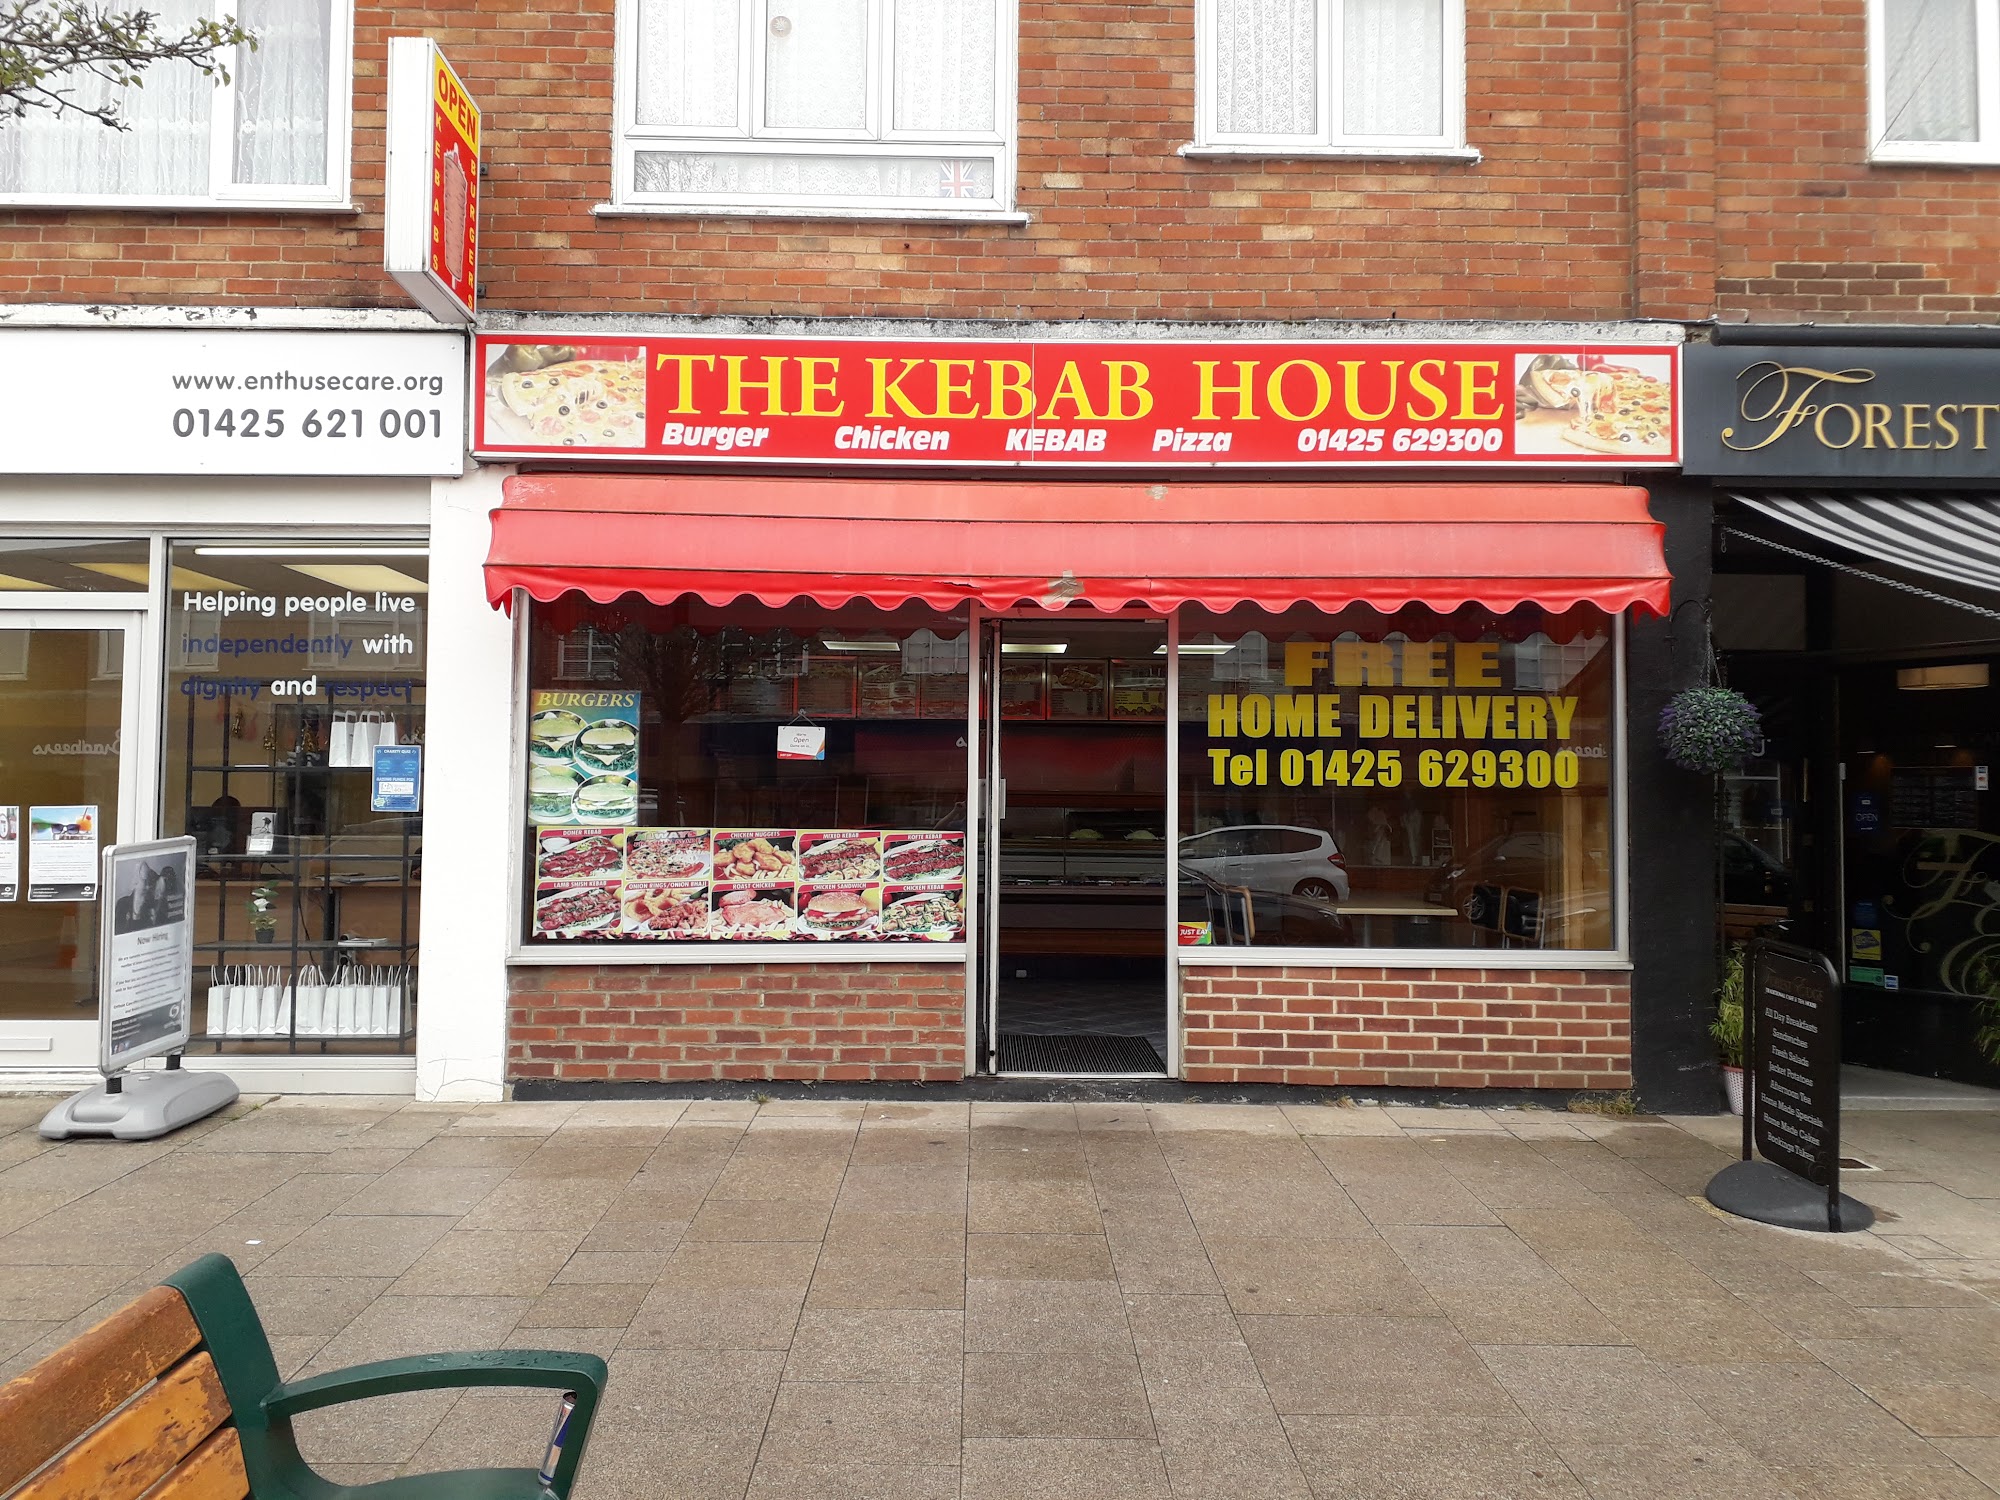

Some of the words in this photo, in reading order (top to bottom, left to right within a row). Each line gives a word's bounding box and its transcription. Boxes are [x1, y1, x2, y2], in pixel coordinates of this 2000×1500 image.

[438, 68, 477, 145] OPEN
[432, 111, 442, 272] KEBABS
[467, 158, 477, 310] BURGERS
[171, 370, 444, 396] www.enthusecare.org
[656, 352, 845, 418] THE
[865, 357, 1154, 422] KEBAB
[1191, 358, 1505, 422] HOUSE
[1721, 361, 2000, 451] FOREST
[172, 408, 285, 438] 01425
[302, 408, 364, 438] 621
[379, 408, 442, 438] 001
[660, 422, 770, 452] Burger
[834, 425, 950, 452] Chicken
[1005, 427, 1107, 452] KEBAB
[1152, 426, 1233, 452] Pizza
[1297, 427, 1385, 452] 01425
[1392, 427, 1503, 452] 629300
[183, 590, 277, 617] Helping
[284, 591, 367, 617] people
[375, 591, 415, 612] live
[182, 633, 353, 659] independently
[362, 633, 413, 654] with
[1284, 642, 1502, 687] FREE
[180, 675, 261, 700] dignity
[271, 675, 317, 696] and
[324, 679, 413, 702] respect
[537, 692, 635, 708] BURGERS
[1207, 694, 1342, 738] HOME
[1359, 695, 1579, 740] DELIVERY
[1207, 748, 1268, 786] Tel
[1279, 749, 1403, 787] 01425
[1418, 749, 1580, 789] 629300
[1765, 1007, 1774, 1018] All
[1774, 1010, 1785, 1024] Day
[1786, 1014, 1818, 1034] Breakfasts
[1772, 1028, 1808, 1049] Sandwiches
[1771, 1044, 1788, 1060] Fresh
[1788, 1051, 1809, 1067] Salads
[1768, 1061, 1786, 1076] Jacket
[1787, 1068, 1814, 1087] Potatoes
[1770, 1080, 1800, 1100] Afternoon
[1800, 1091, 1812, 1105] Tea
[1761, 1092, 1777, 1107] Home
[1778, 1100, 1795, 1116] Made
[1795, 1109, 1824, 1128] Specials
[1763, 1112, 1780, 1128] Home
[1781, 1120, 1798, 1137] Made
[1799, 1129, 1820, 1146] Cakes
[1767, 1131, 1794, 1153] Bookings
[1794, 1144, 1815, 1162] Taken
